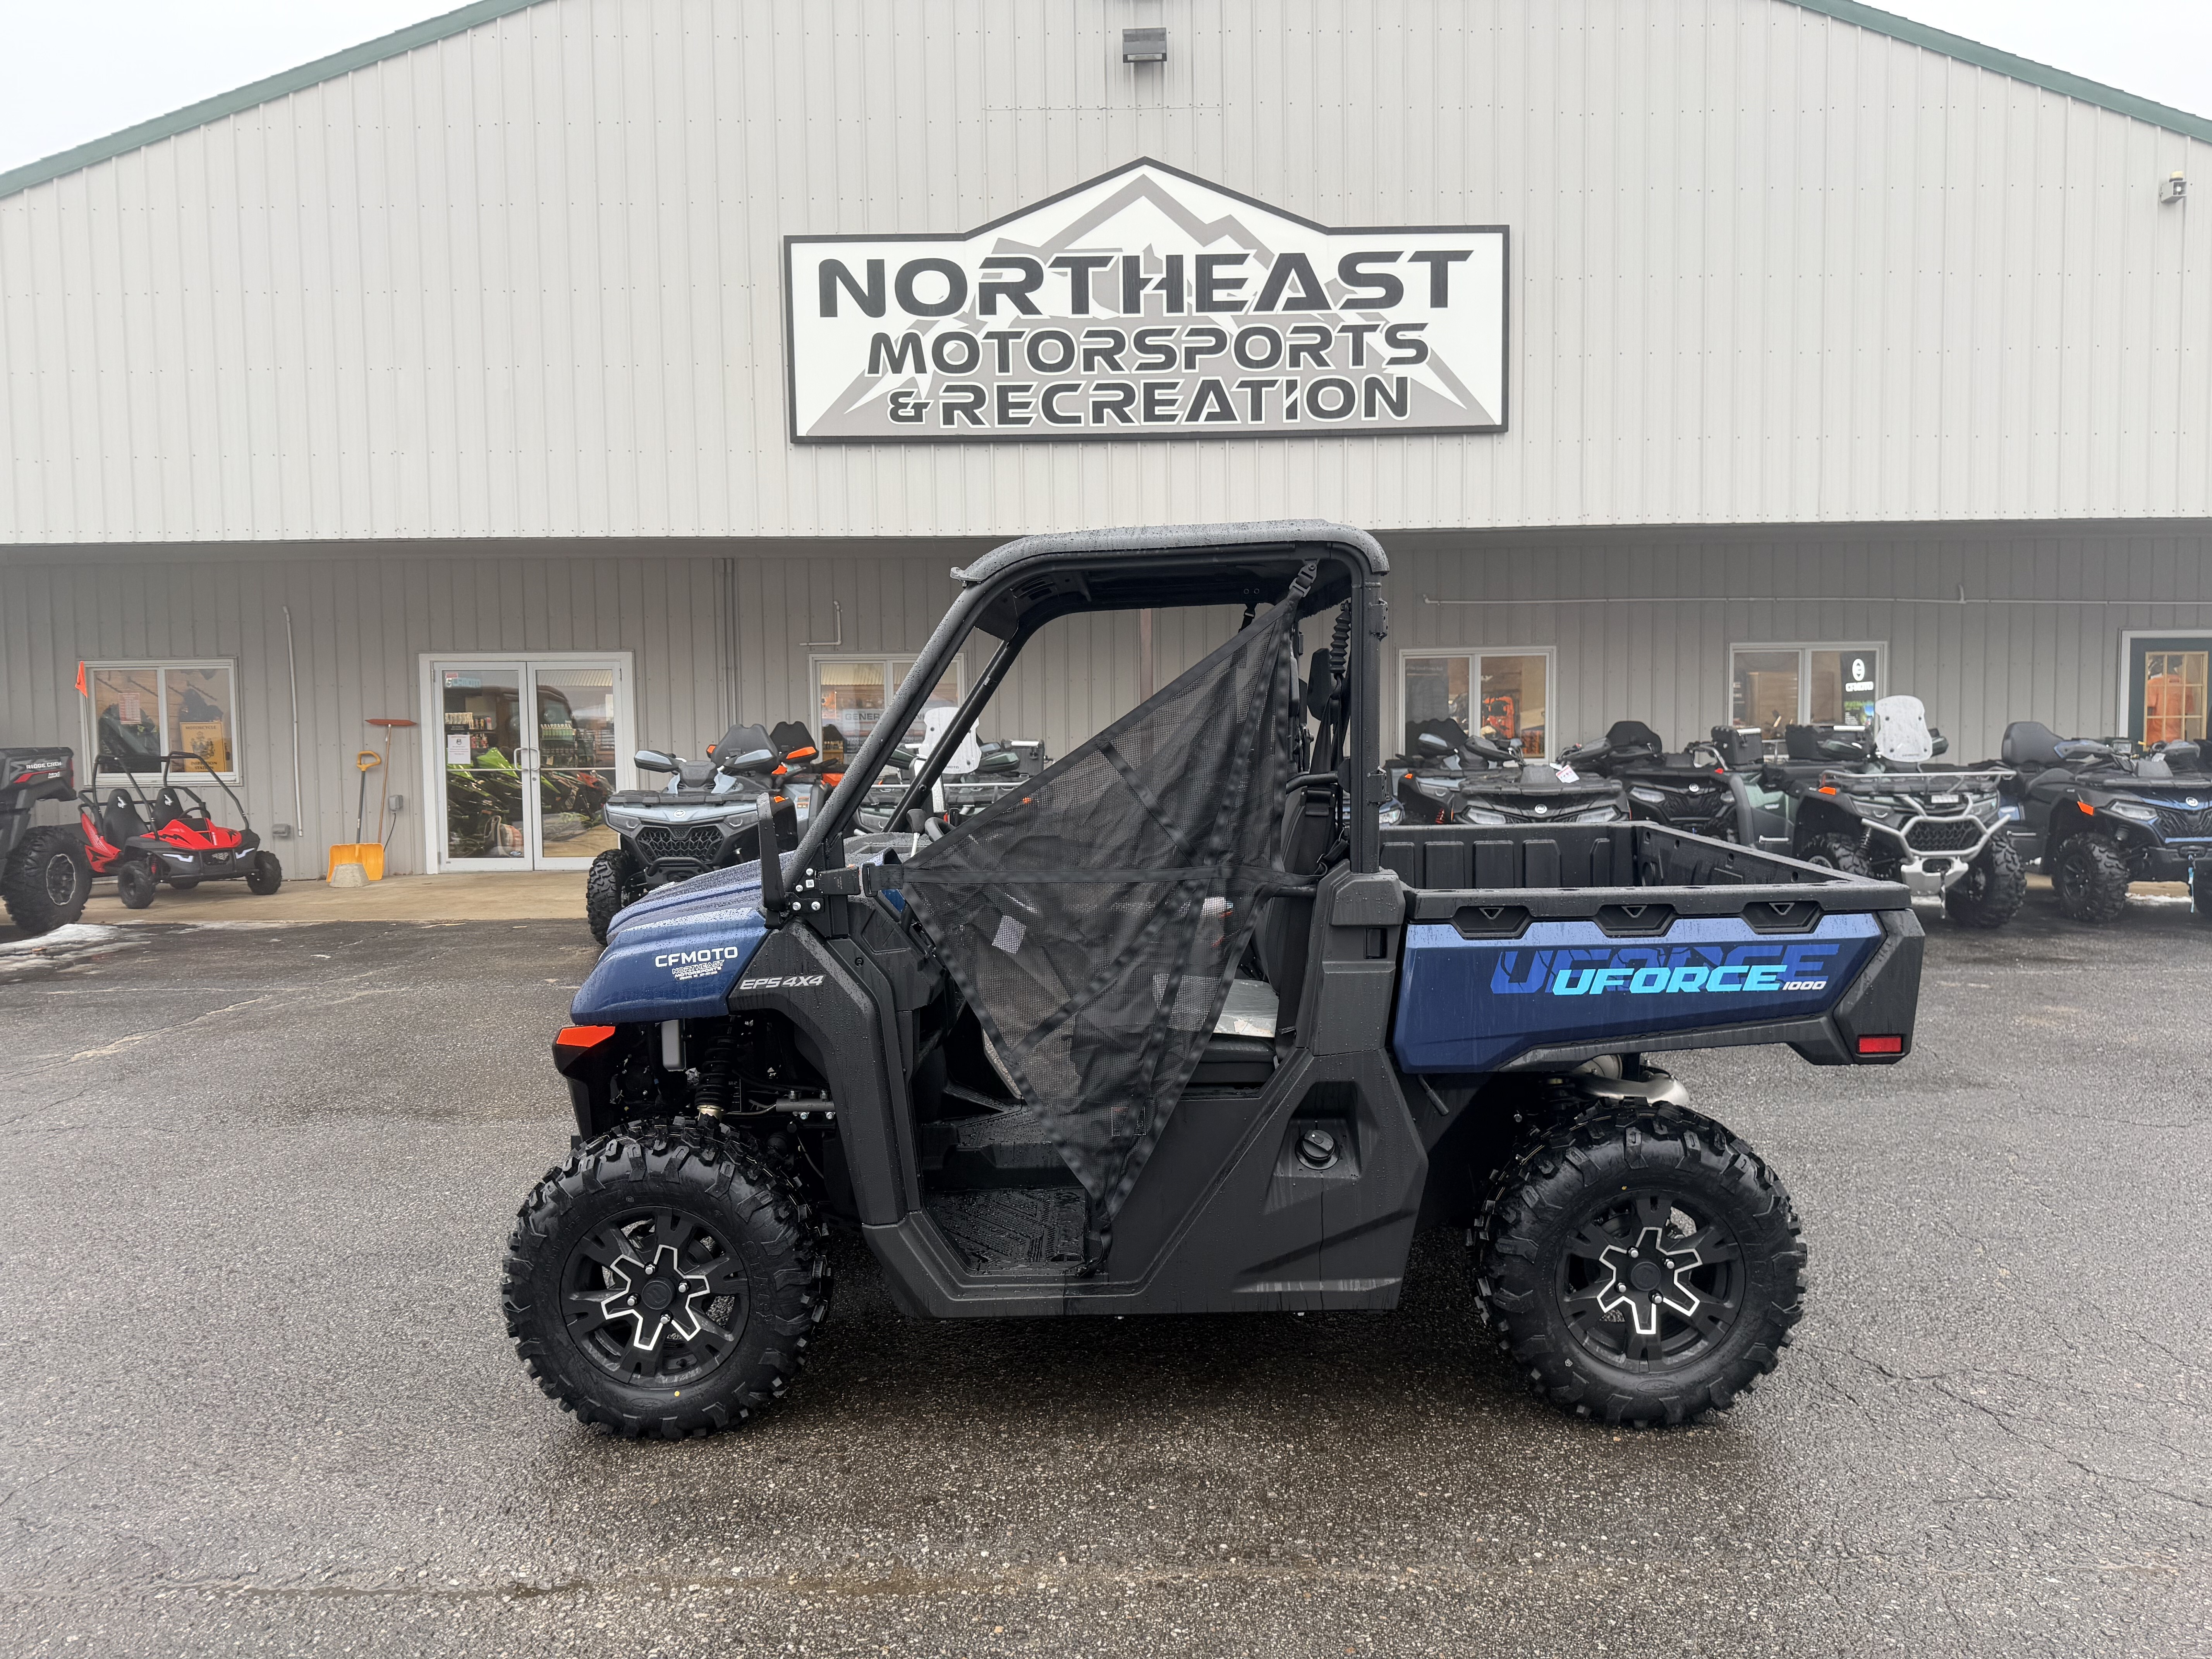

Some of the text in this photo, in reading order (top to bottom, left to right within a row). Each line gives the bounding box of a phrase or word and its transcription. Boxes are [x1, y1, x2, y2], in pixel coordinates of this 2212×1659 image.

[819, 250, 1474, 318] NORTHEAST
[867, 323, 1429, 374] MOTORSPORTS
[941, 376, 1408, 426] RECREATION
[655, 946, 738, 967] CFMOTO
[672, 959, 725, 975] NORTHEAST
[740, 975, 824, 989] EPS 4X4
[1552, 965, 1827, 995] UFORCE 1000
